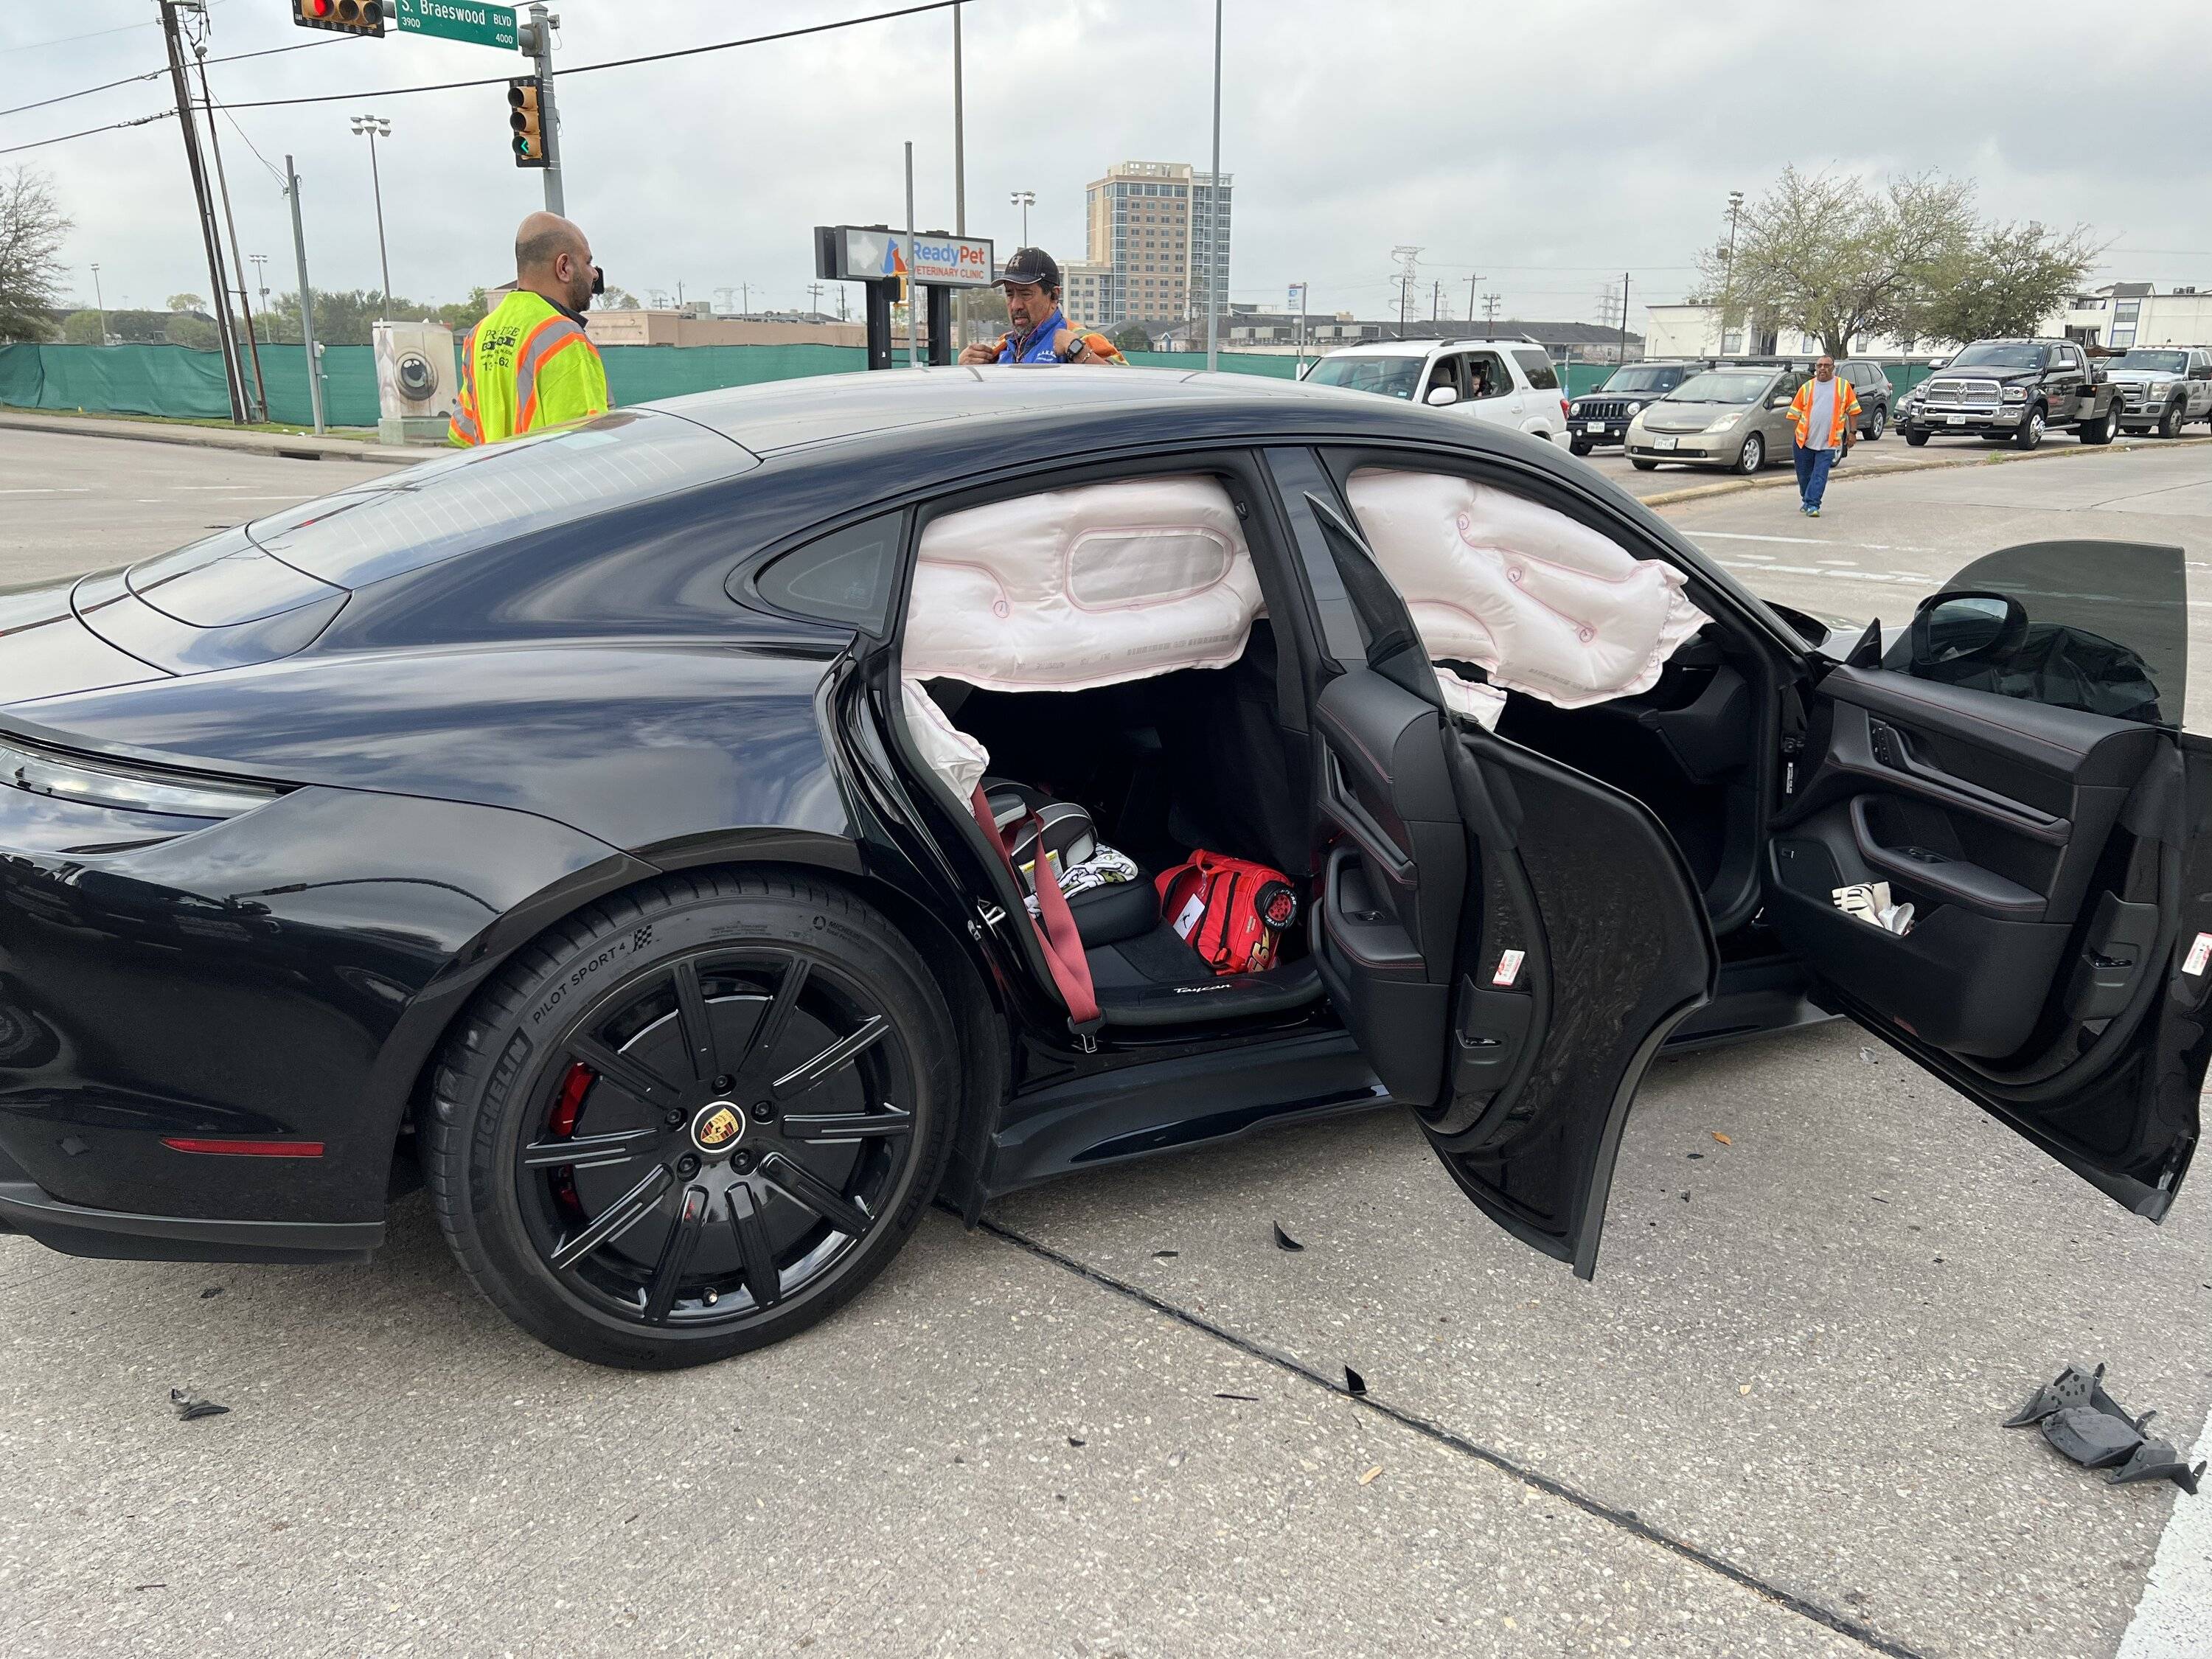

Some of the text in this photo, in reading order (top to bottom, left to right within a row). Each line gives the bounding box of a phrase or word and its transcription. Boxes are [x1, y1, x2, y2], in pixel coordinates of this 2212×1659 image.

[401, 0, 512, 27] S. Braeswood BLVD
[401, 16, 421, 28] 3900
[495, 33, 513, 44] 4000
[914, 241, 985, 266] ReadyPet
[960, 269, 984, 279] CLINIC
[533, 983, 567, 1024] PILOT
[571, 947, 616, 986] SPORT
[619, 942, 626, 950] 4
[1173, 984, 1232, 993] Taycan
[474, 1035, 529, 1169] MICHELIN
